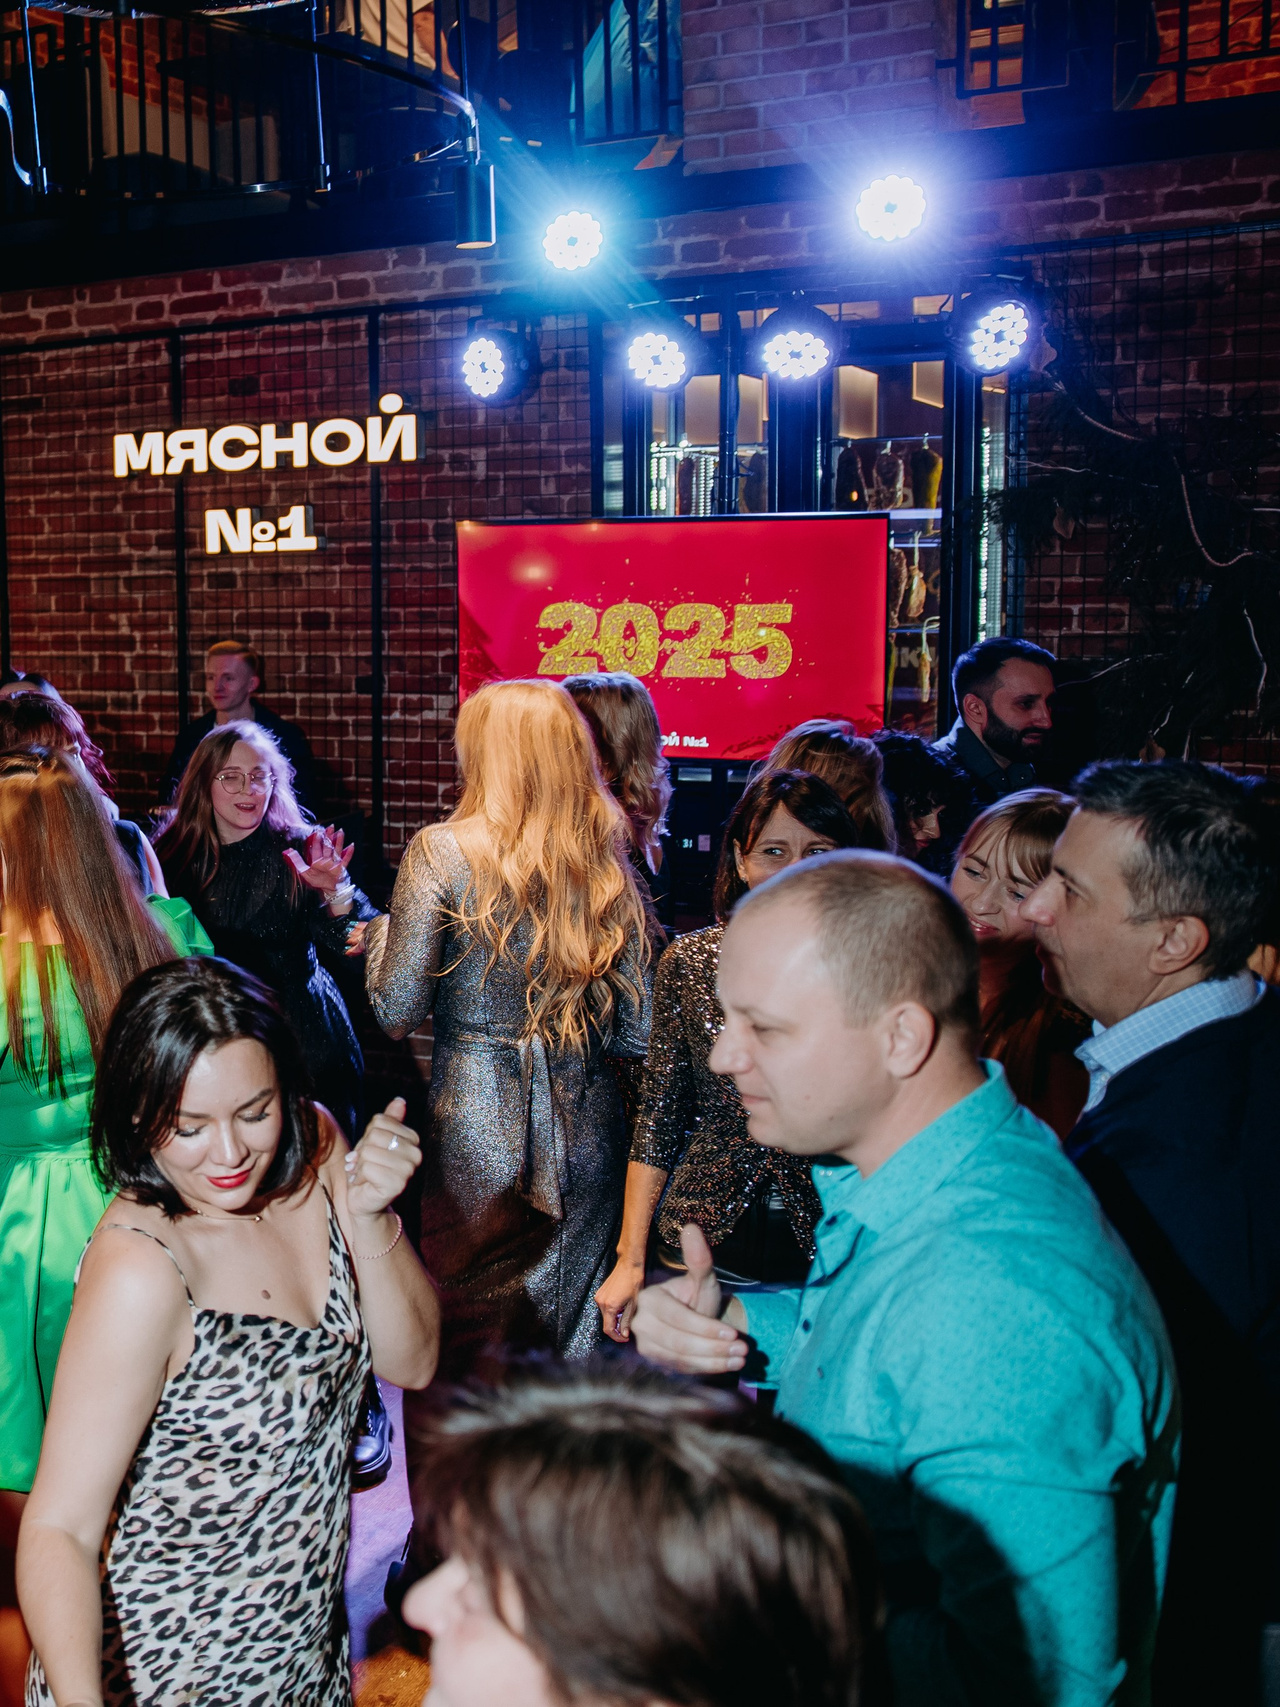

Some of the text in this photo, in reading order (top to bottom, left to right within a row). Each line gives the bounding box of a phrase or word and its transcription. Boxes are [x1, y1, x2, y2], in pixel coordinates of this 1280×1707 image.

[113, 393, 417, 477] МЯСНОЙ
[205, 505, 318, 554] №1
[537, 602, 793, 678] 2025
